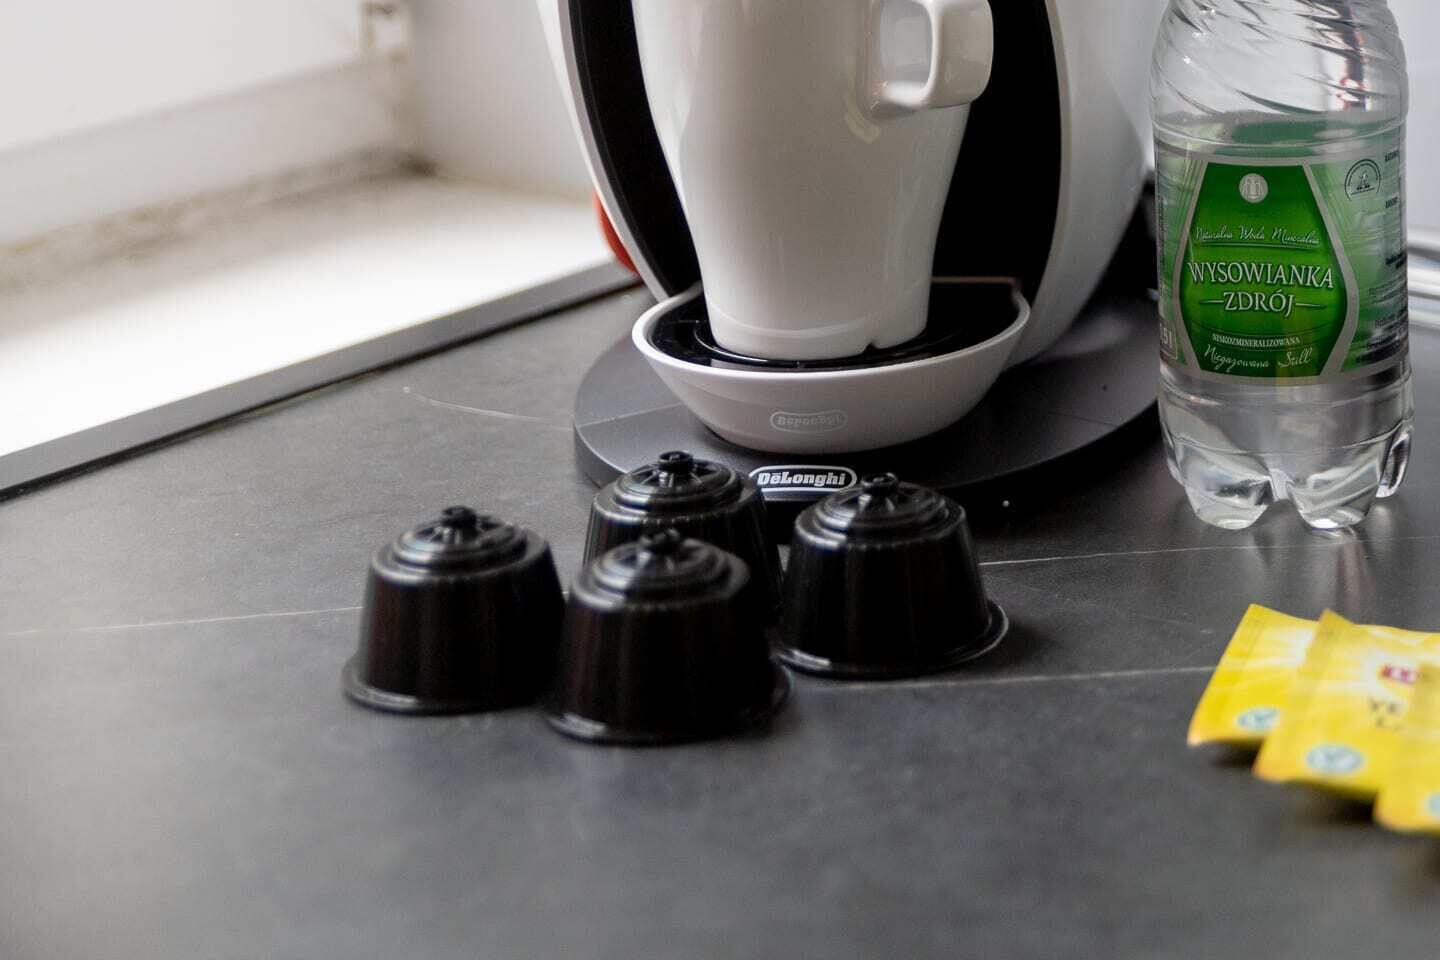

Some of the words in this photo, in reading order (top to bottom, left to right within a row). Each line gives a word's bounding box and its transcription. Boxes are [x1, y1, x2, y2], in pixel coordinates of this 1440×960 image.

[1188, 261, 1334, 289] WYSOWIANKA
[1223, 289, 1296, 317] ZDRÓJ
[1277, 347, 1313, 369] Still
